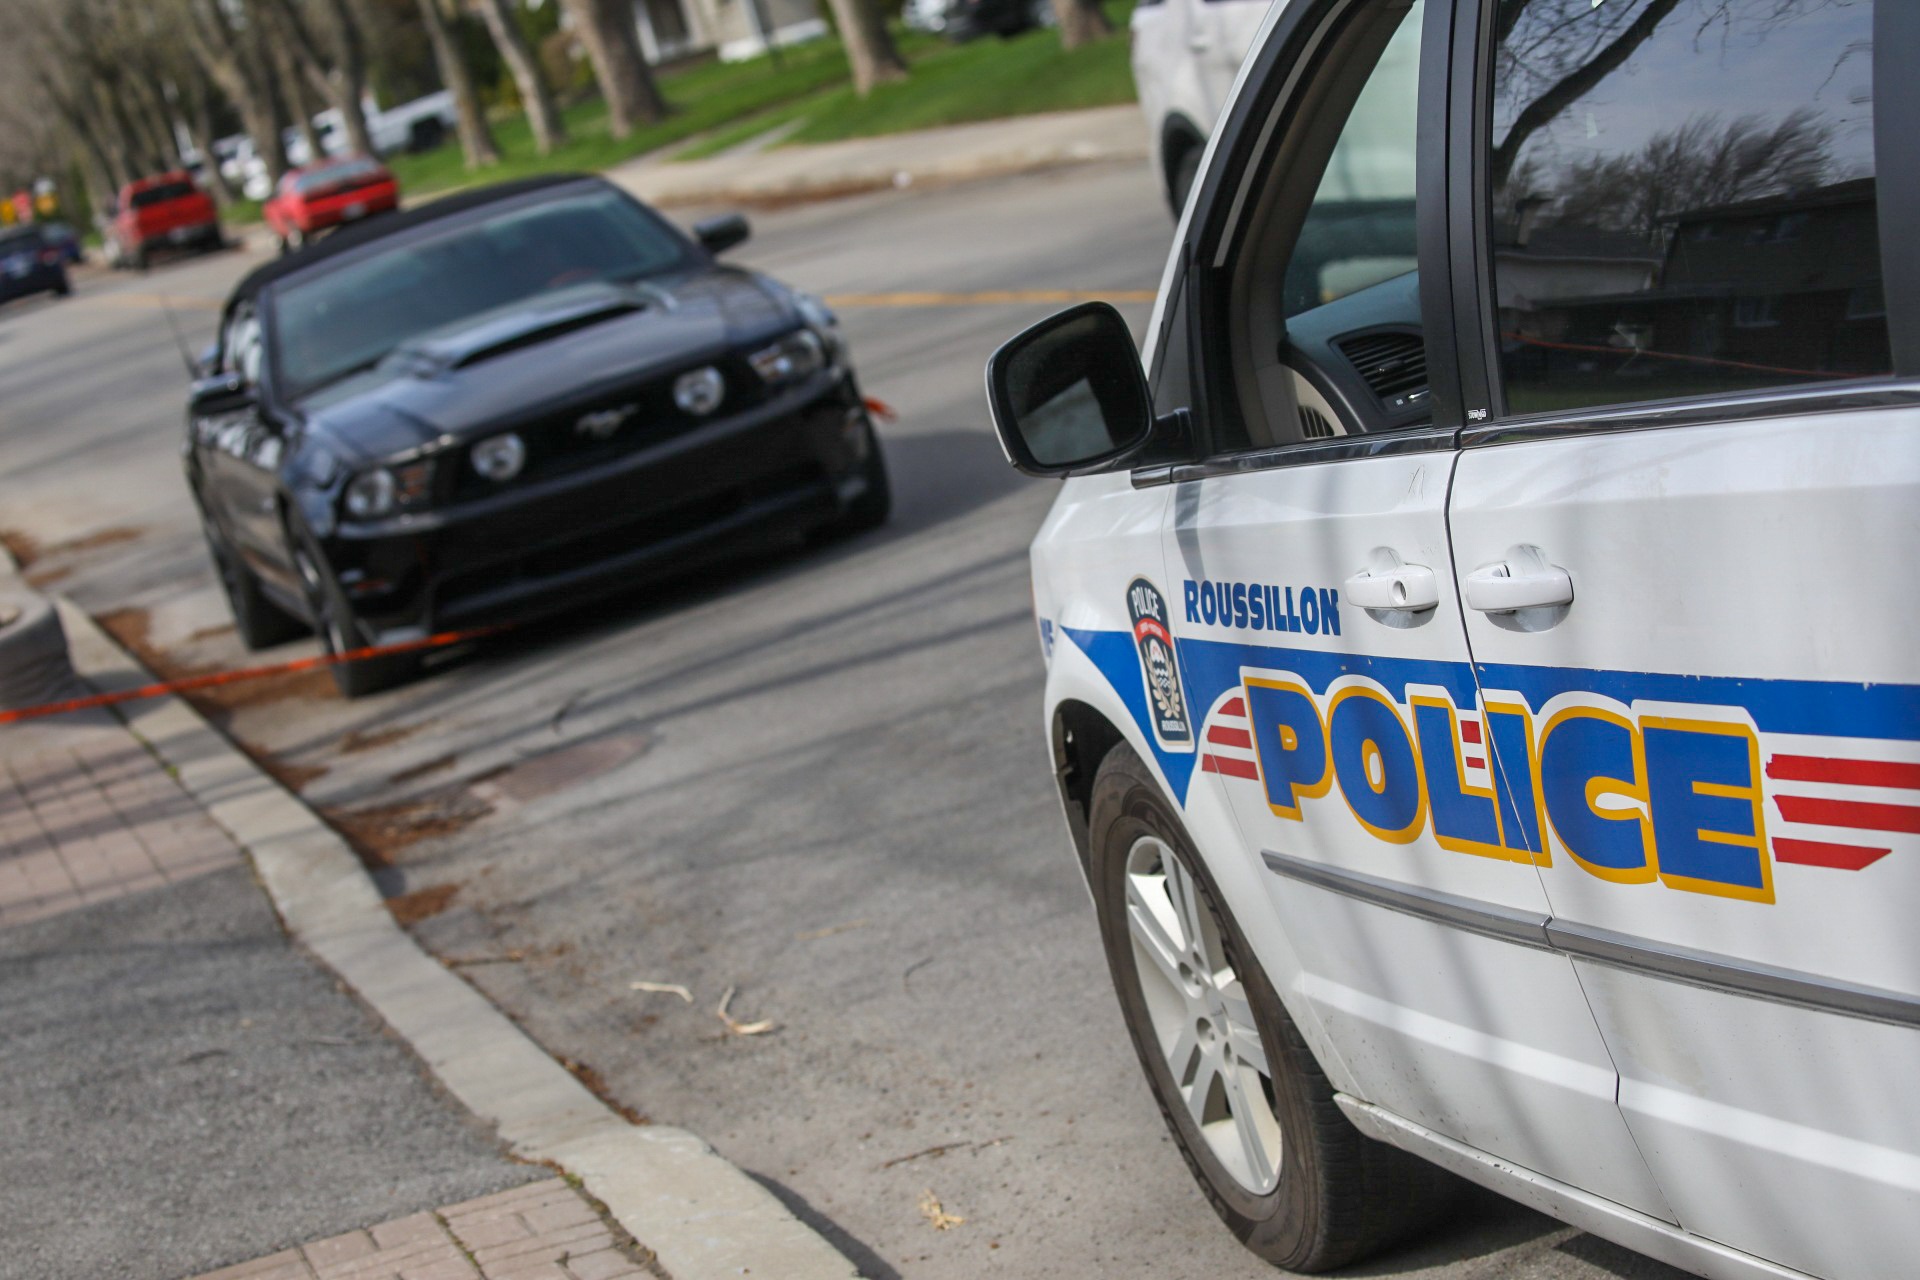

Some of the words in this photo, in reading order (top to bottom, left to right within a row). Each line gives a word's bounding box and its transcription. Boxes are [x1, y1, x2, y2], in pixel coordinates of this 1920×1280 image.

[1131, 586, 1161, 622] POLICE
[1183, 579, 1341, 636] ROUSSILLON
[1240, 674, 1777, 906] POLICE
